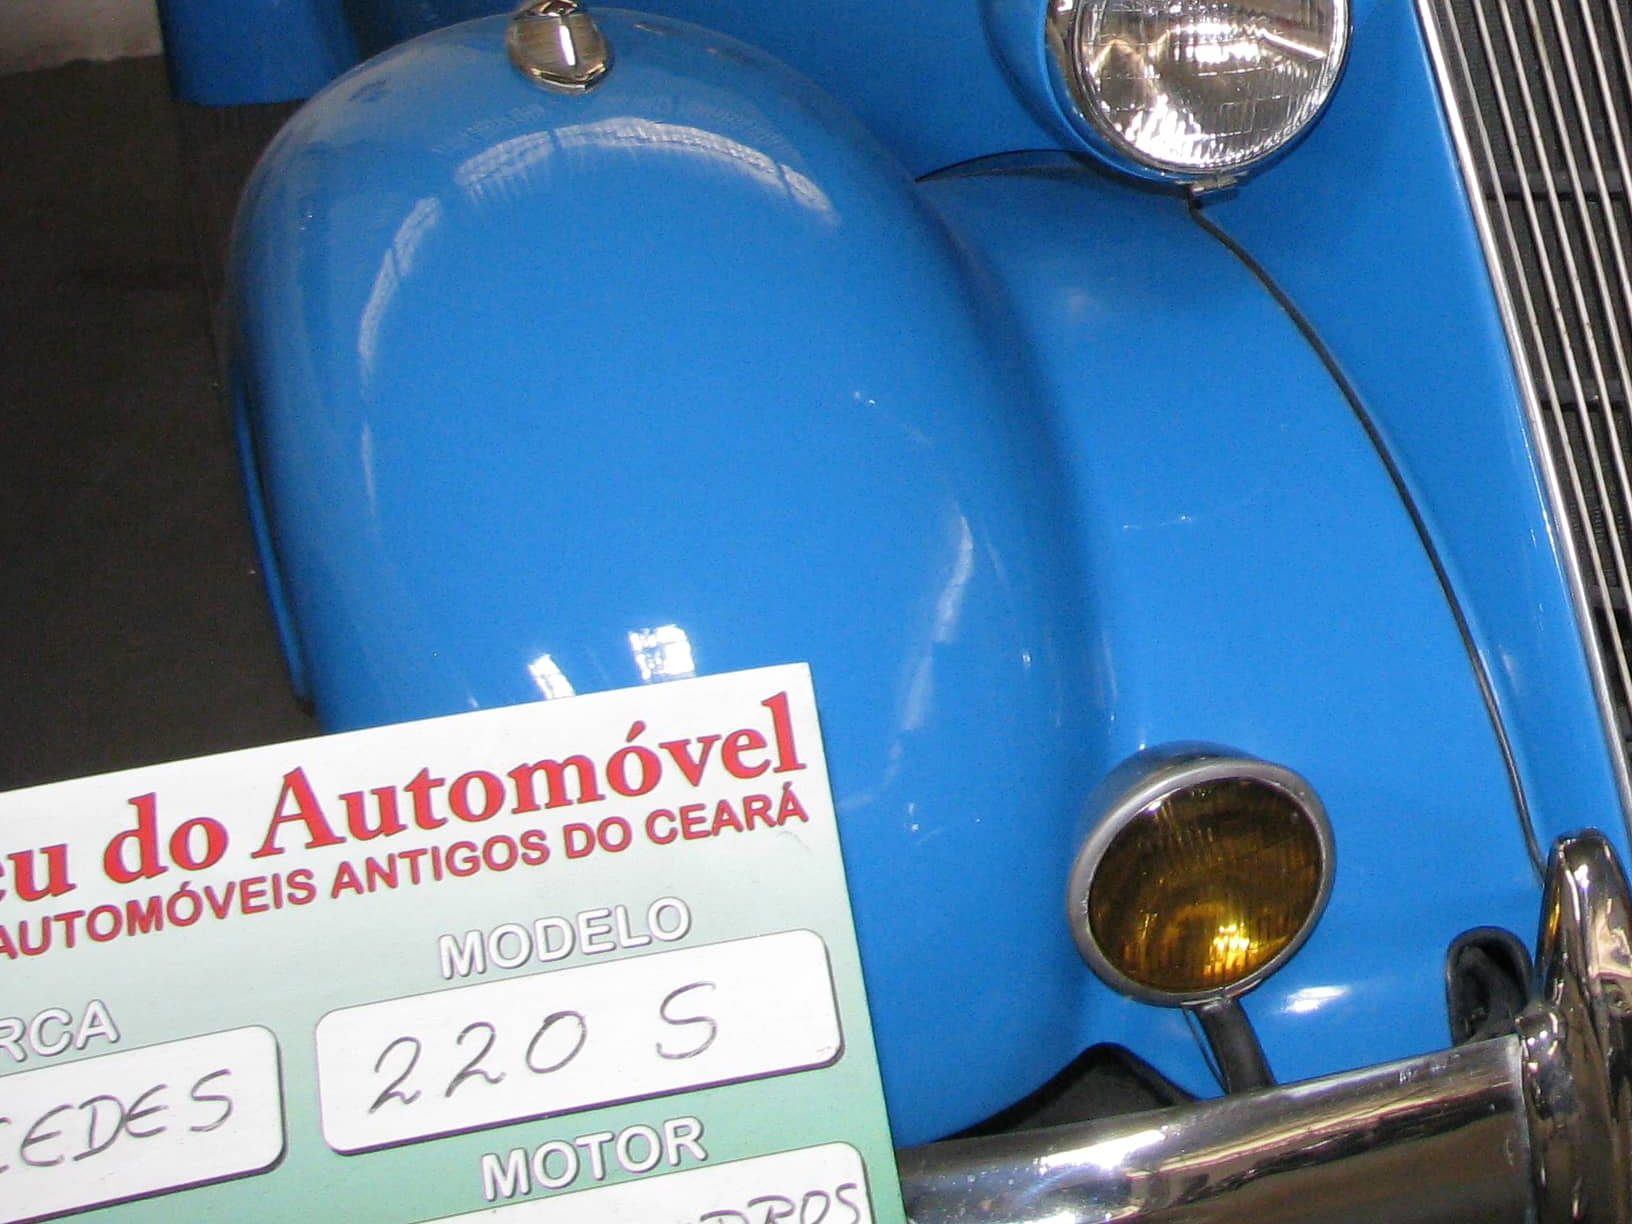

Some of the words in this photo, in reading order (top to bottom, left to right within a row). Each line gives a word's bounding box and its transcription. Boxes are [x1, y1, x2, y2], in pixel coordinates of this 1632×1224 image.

[103, 791, 230, 885] do
[251, 691, 808, 859] Automóvel
[331, 817, 551, 900] ANTIGOS
[565, 813, 633, 860] DO
[645, 782, 811, 845] CEARÁ
[439, 896, 694, 980] MODELO
[369, 1009, 588, 1115] 220
[655, 980, 718, 1059] S
[481, 1116, 709, 1201] MOTOR
